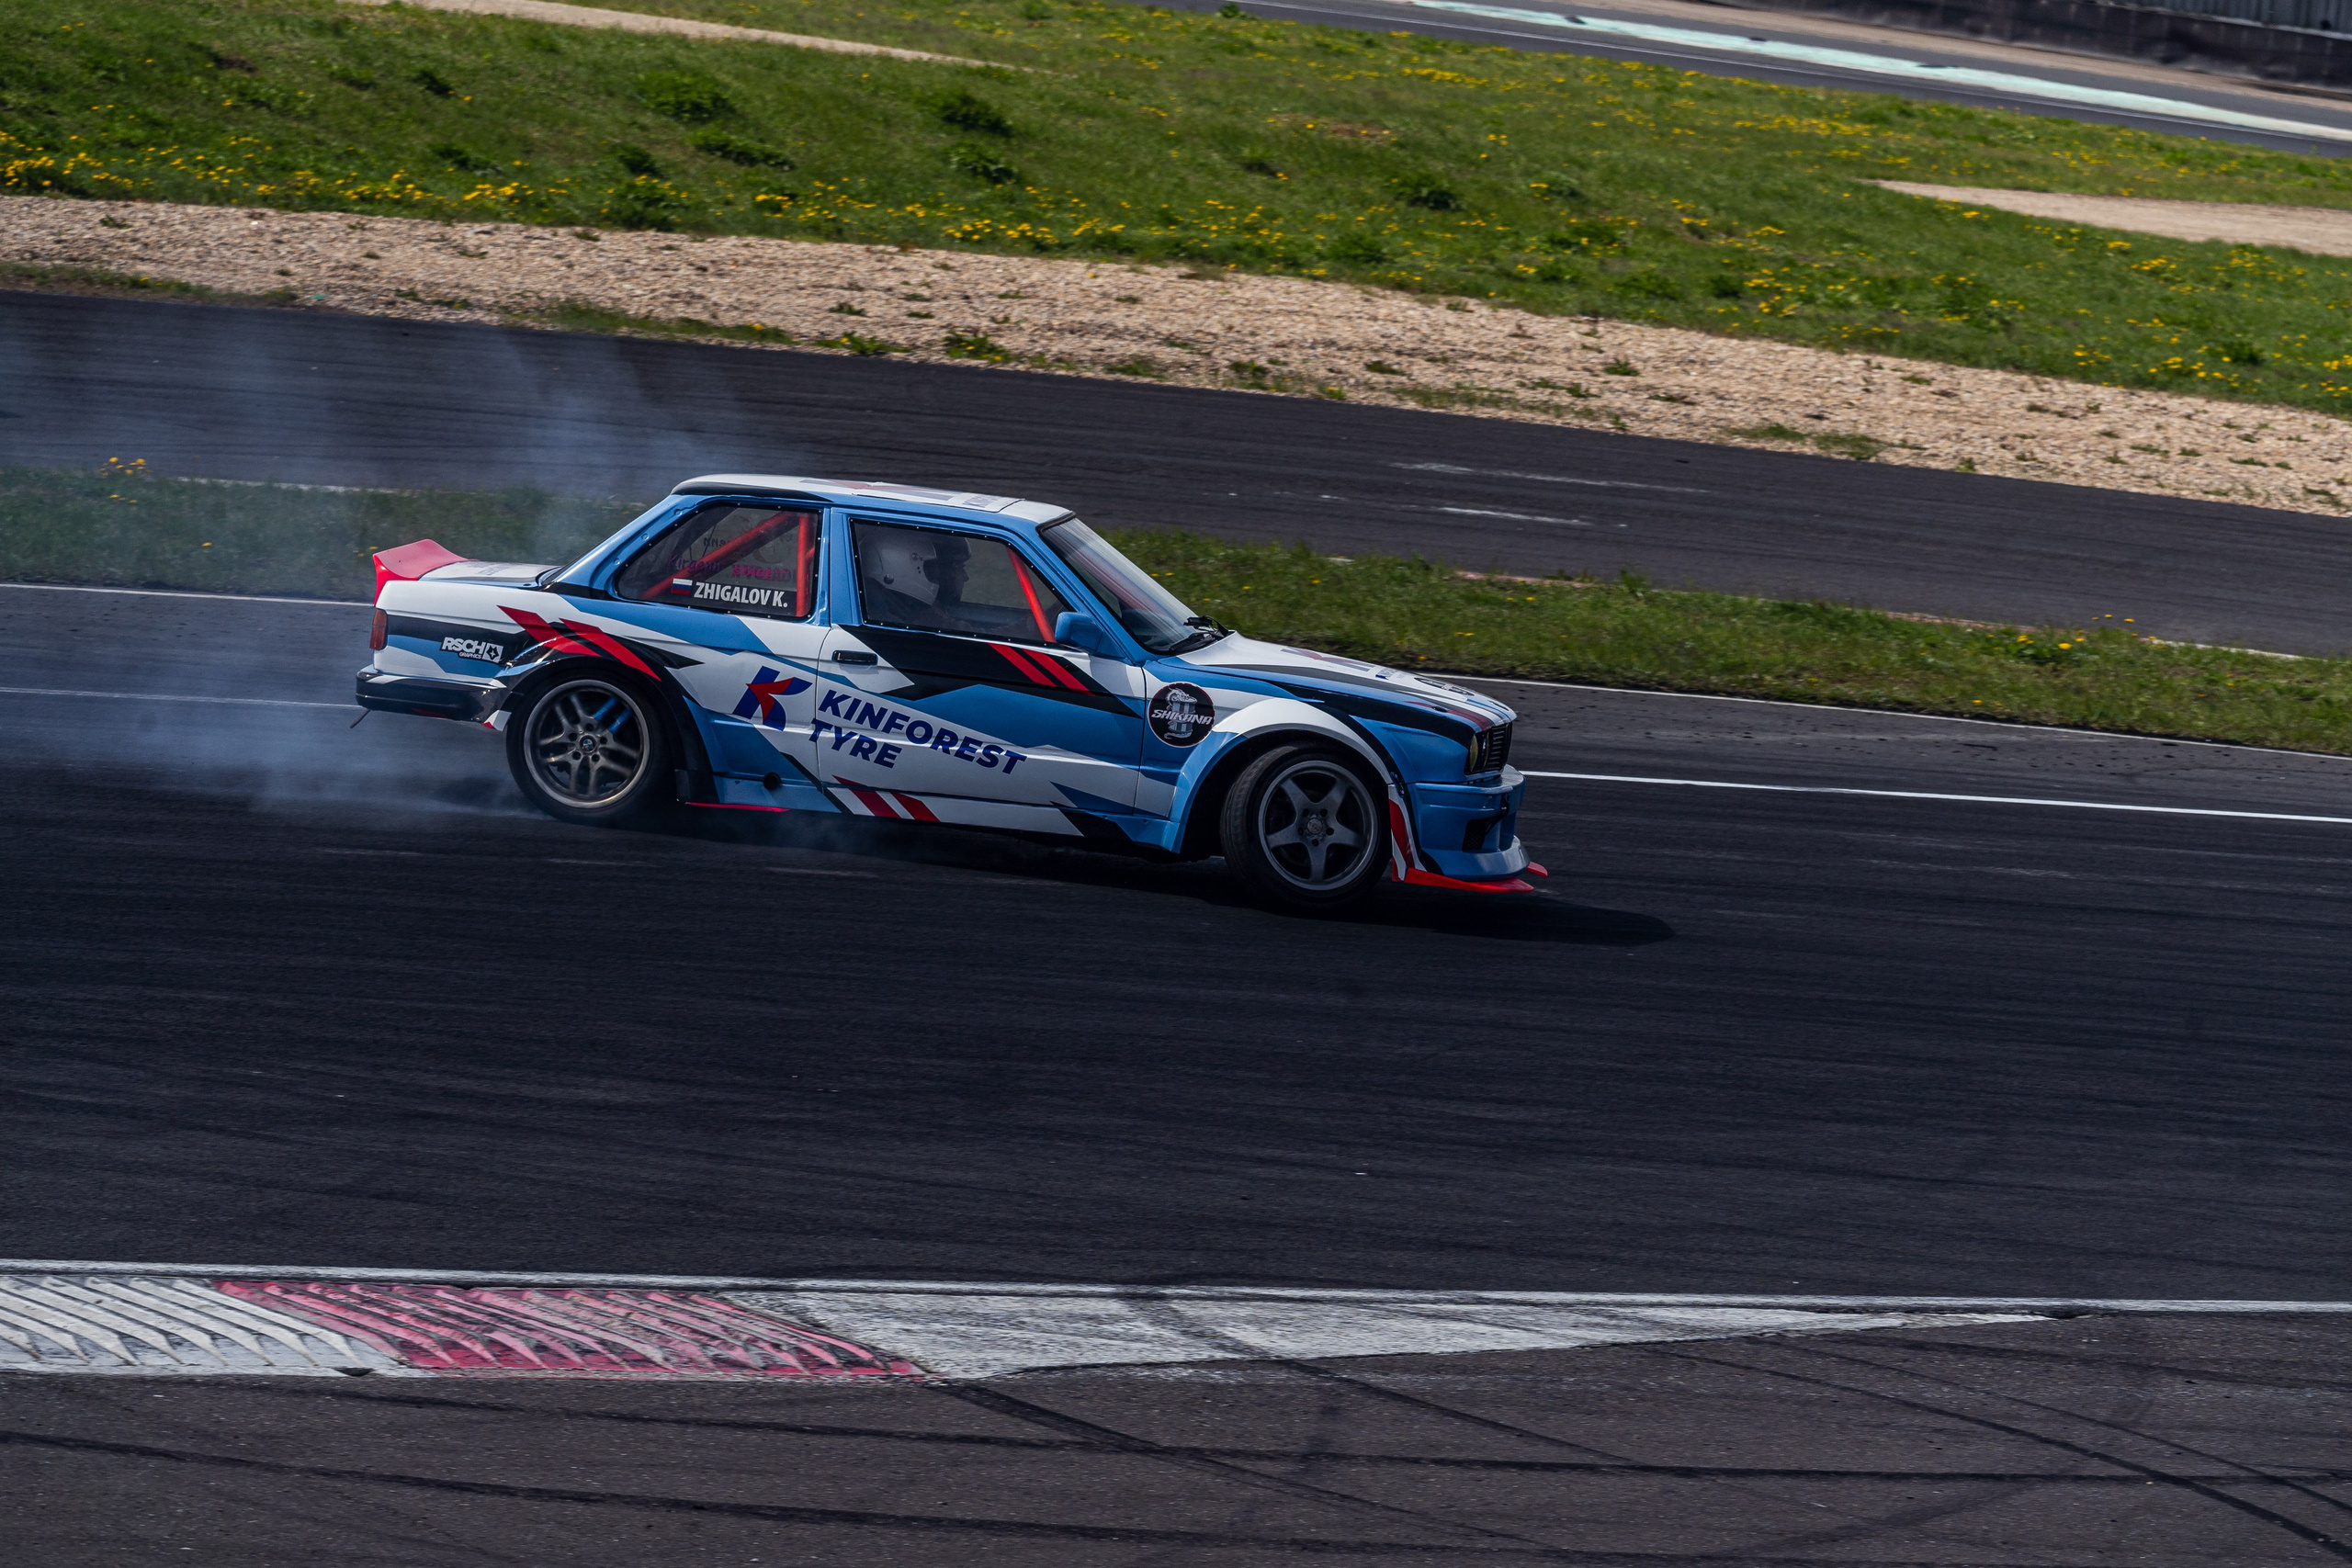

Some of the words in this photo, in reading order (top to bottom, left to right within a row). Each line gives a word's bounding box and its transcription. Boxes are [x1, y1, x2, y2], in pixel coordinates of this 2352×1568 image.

[732, 565, 772, 578] STAGE
[694, 581, 772, 605] ZHIGALOV
[772, 591, 788, 608] K.
[441, 637, 487, 655] RSCH
[458, 651, 482, 660] GRAPHICS
[1151, 709, 1214, 726] SHIKANA
[818, 689, 1027, 774] KINFOREST
[808, 717, 903, 769] TYRE
